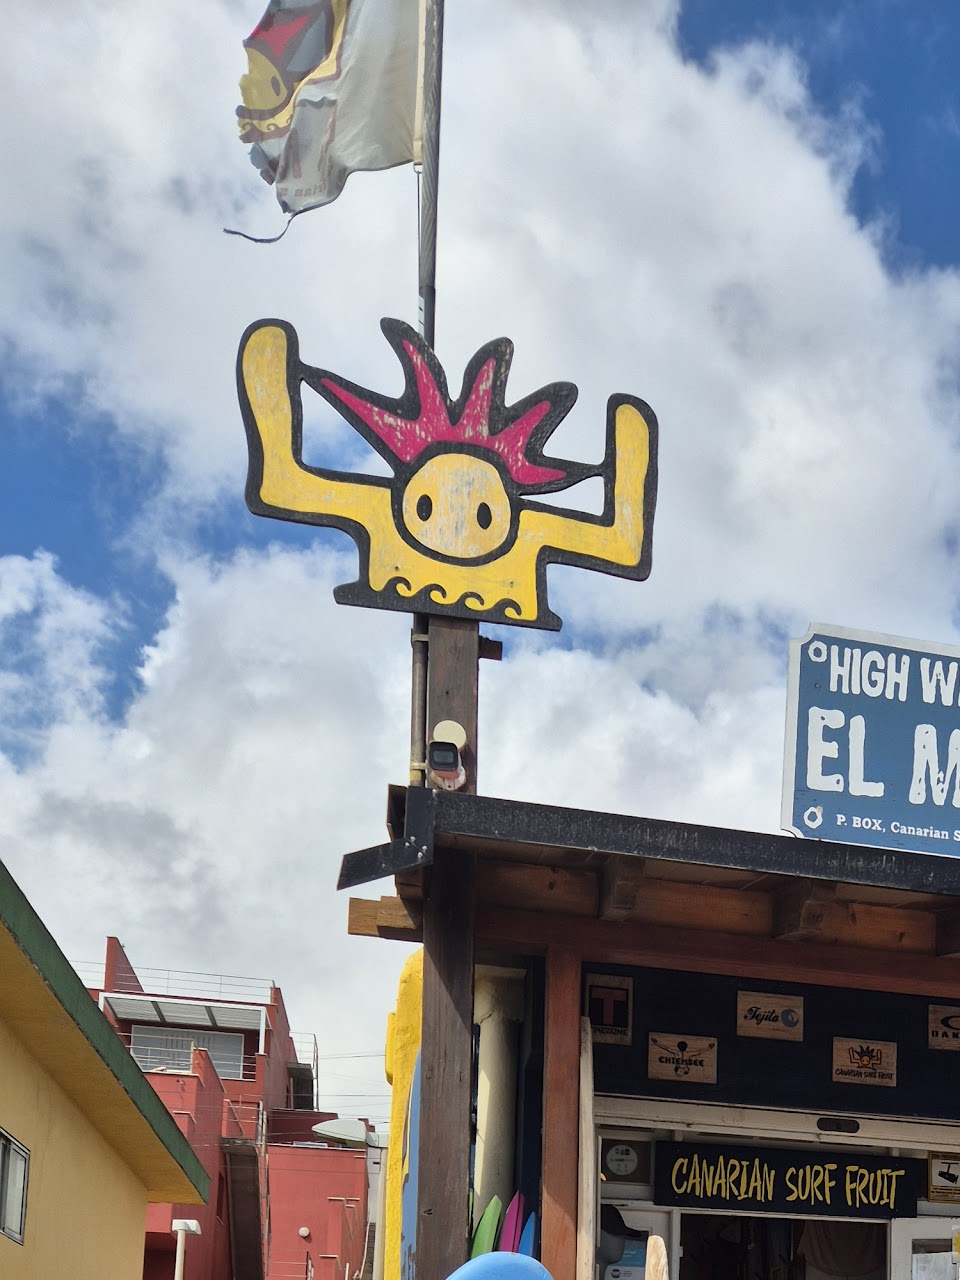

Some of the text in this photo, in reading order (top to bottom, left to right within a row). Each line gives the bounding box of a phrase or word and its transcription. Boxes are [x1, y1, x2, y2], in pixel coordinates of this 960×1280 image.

[830, 645, 911, 702] HIGH
[806, 706, 884, 797] EL
[836, 814, 847, 826] P.
[852, 816, 886, 833] BOX,
[890, 821, 949, 840] Canarian
[744, 1006, 779, 1025] Tejita
[658, 1056, 704, 1067] CHIEMSEE
[672, 1153, 906, 1209] CANARIAN SURF FRUIT
